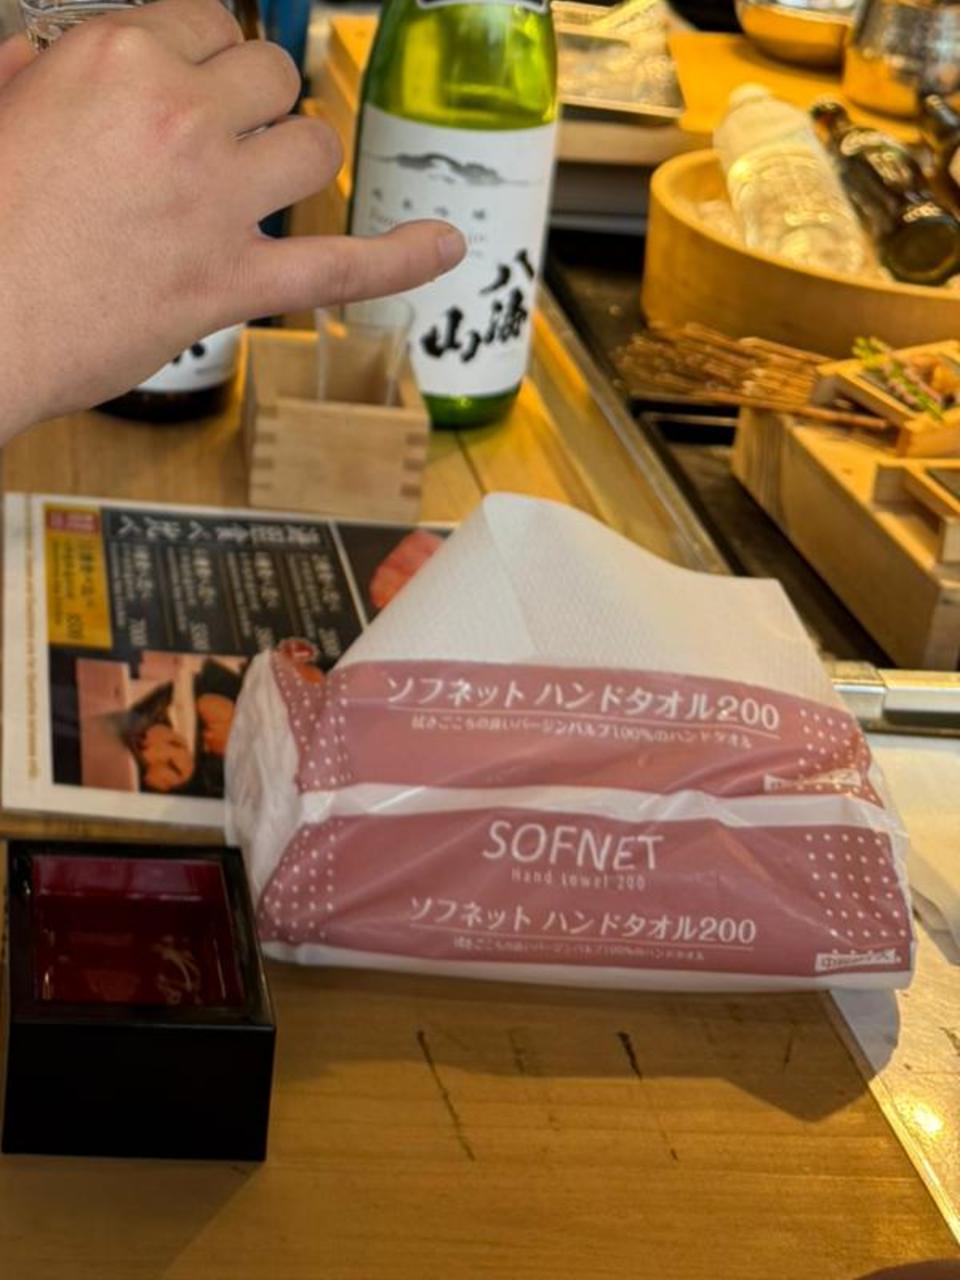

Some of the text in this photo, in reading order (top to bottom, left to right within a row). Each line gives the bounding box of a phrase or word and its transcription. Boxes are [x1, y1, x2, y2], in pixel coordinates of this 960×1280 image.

[386, 677, 780, 731] ソフネット ハンドタオル200
[483, 820, 664, 871] SOFNET
[410, 897, 757, 944] ソフネット ハンドタオル200
